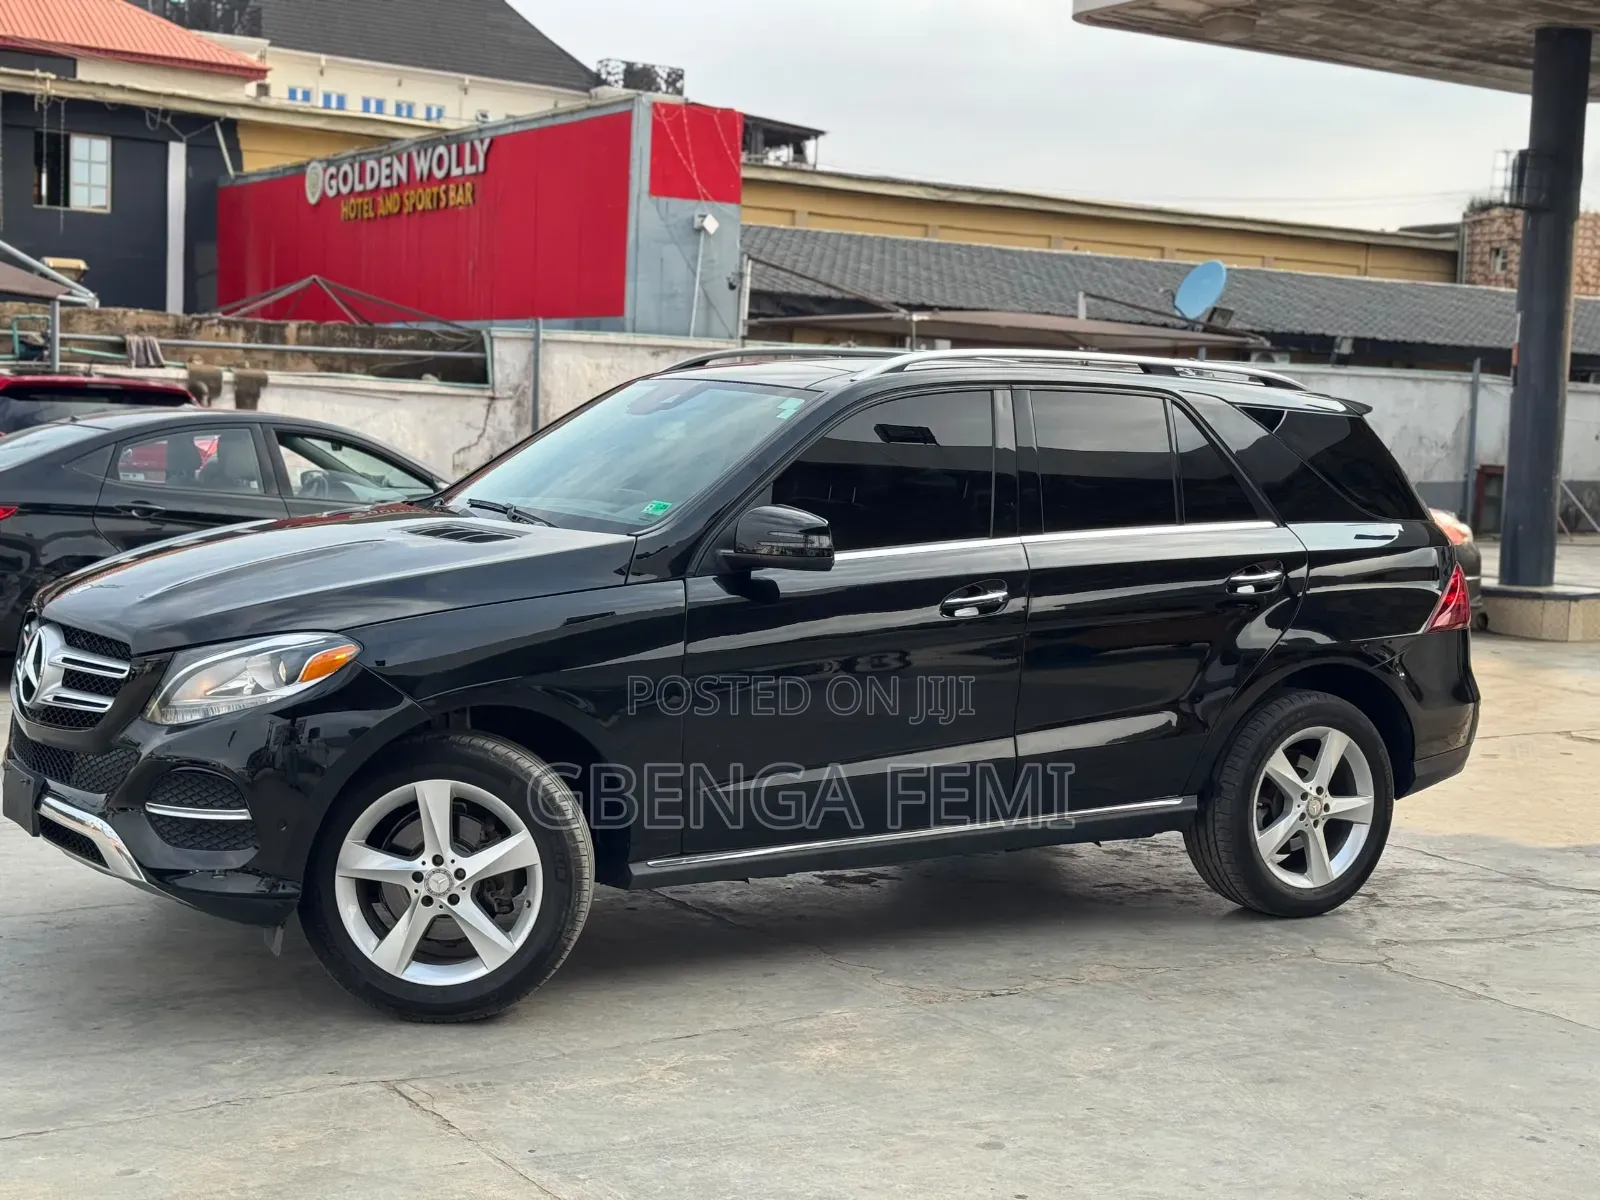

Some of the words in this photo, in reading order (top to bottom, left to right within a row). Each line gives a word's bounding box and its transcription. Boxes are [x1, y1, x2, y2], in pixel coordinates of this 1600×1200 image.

[324, 153, 408, 197] GOLDEN
[412, 137, 493, 181] WOLLY
[341, 197, 375, 220] HOTEL
[378, 192, 400, 216] AND
[403, 184, 447, 215] SPORTS
[449, 182, 473, 208] BAR
